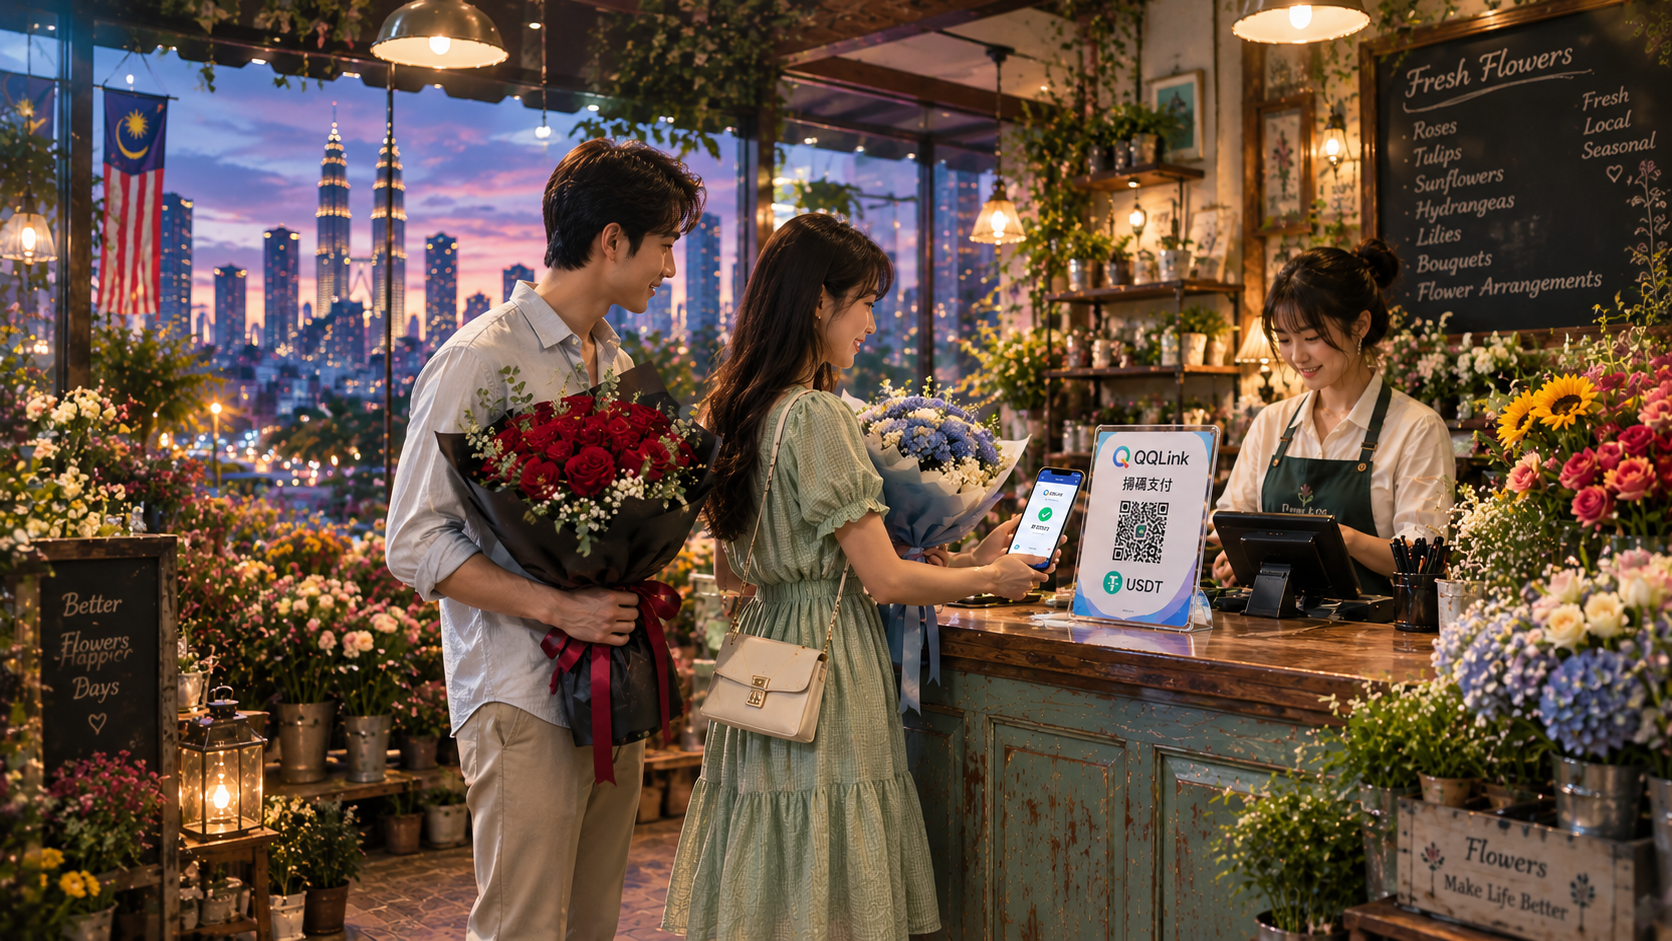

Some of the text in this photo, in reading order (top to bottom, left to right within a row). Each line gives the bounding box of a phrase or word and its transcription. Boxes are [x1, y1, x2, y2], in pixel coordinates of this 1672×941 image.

[1405, 47, 1573, 98] Fresh Flowers
[1582, 85, 1630, 111] Fresh
[1413, 119, 1457, 141] Roses
[1583, 109, 1632, 135] Local
[1413, 145, 1462, 168] Tulips
[1581, 130, 1657, 160] Seasonal
[1414, 167, 1504, 195] Sunflowers
[1415, 194, 1515, 223] Hydrangeas
[1415, 226, 1462, 247] Lilies
[1416, 250, 1492, 276] Bouquets
[1417, 270, 1603, 302] Flower Arrangements
[1134, 450, 1190, 466] QQLink
[1126, 578, 1163, 594] USDT
[62, 592, 122, 617] Better
[60, 630, 129, 653] Flowers
[72, 676, 120, 704] Days
[1465, 836, 1548, 878] Flowers
[1444, 873, 1570, 921] Make Life Better
